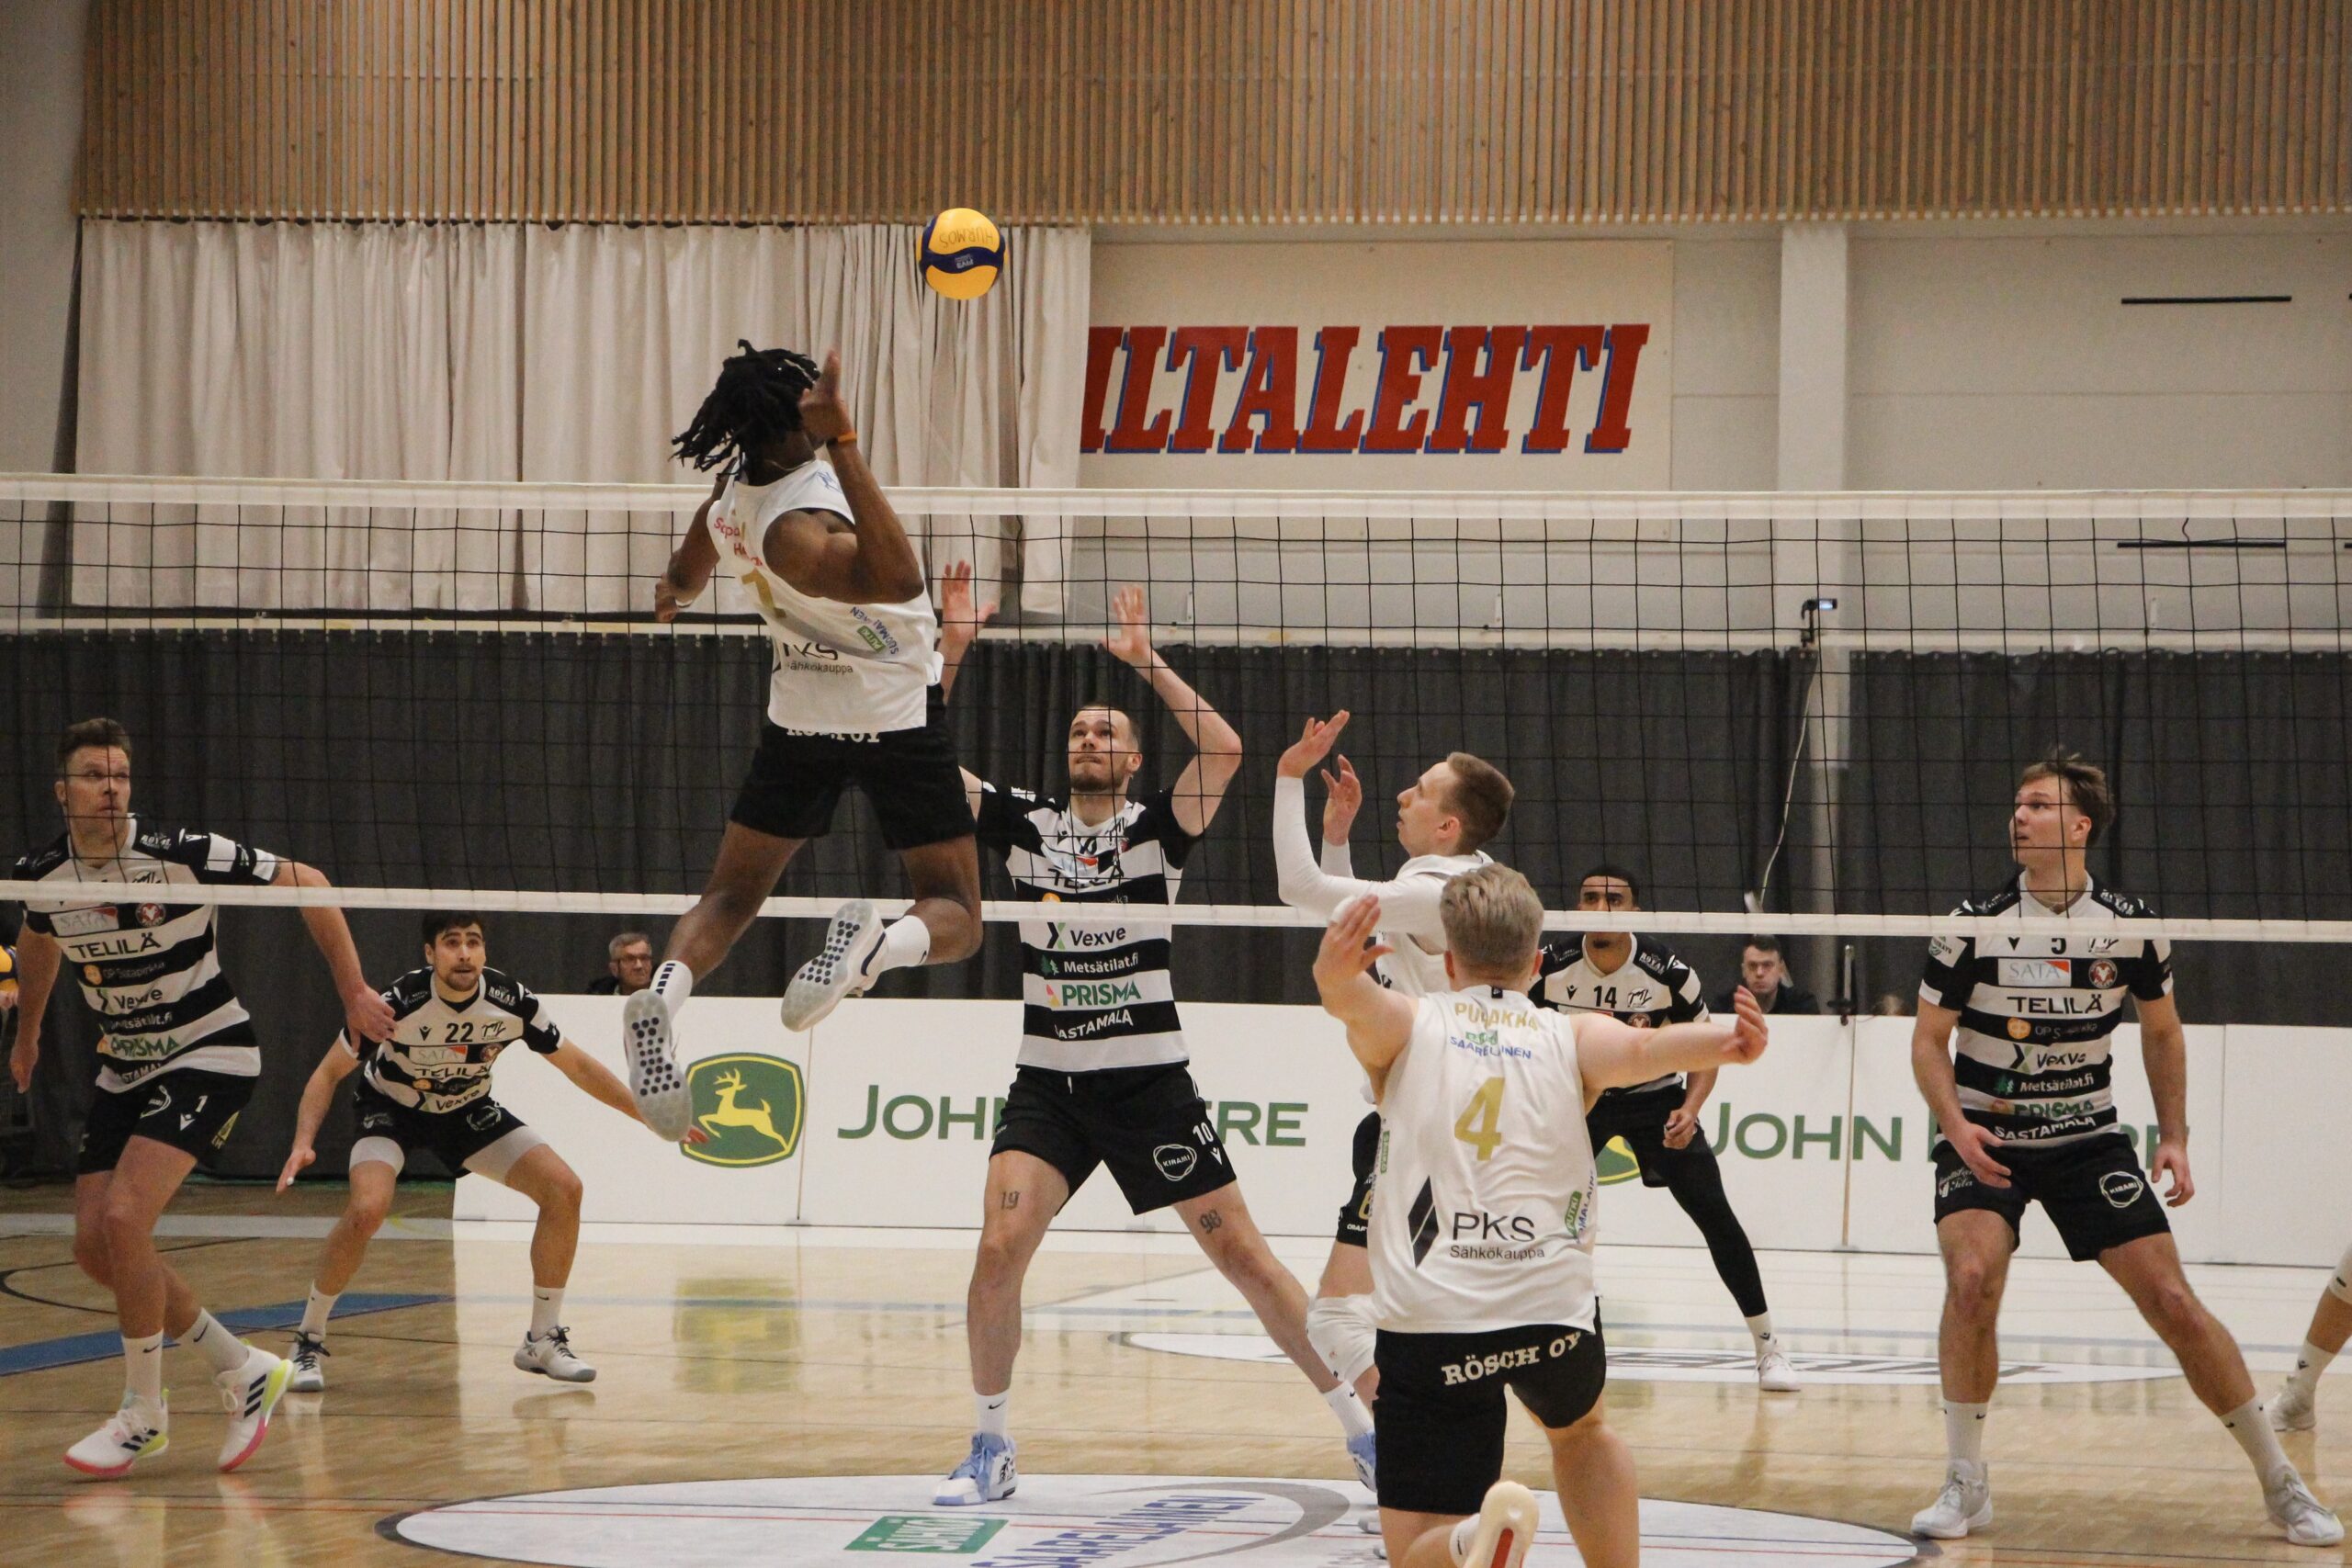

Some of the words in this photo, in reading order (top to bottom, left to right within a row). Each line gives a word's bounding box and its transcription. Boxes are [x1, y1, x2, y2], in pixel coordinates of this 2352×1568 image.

[1080, 324, 1650, 454] ILTALEHTI
[68, 932, 162, 958] TELILÄ
[1070, 927, 1126, 947] Vexve
[1063, 952, 1138, 974] Metsätilat.fi
[1061, 980, 1142, 1006] PRISMA
[1593, 986, 1617, 1009] 14
[2007, 994, 2103, 1014] TELILÄ
[445, 1022, 474, 1043] 22
[1453, 1077, 1505, 1161] 4
[1193, 1122, 1214, 1145] 10
[1711, 1102, 1903, 1161] JOHN
[1162, 1154, 1191, 1168] KIRAMI
[1453, 1213, 1536, 1242] PKS
[1450, 1245, 1545, 1261] Sähkökauppa
[1441, 1346, 1541, 1385] RÖSCH
